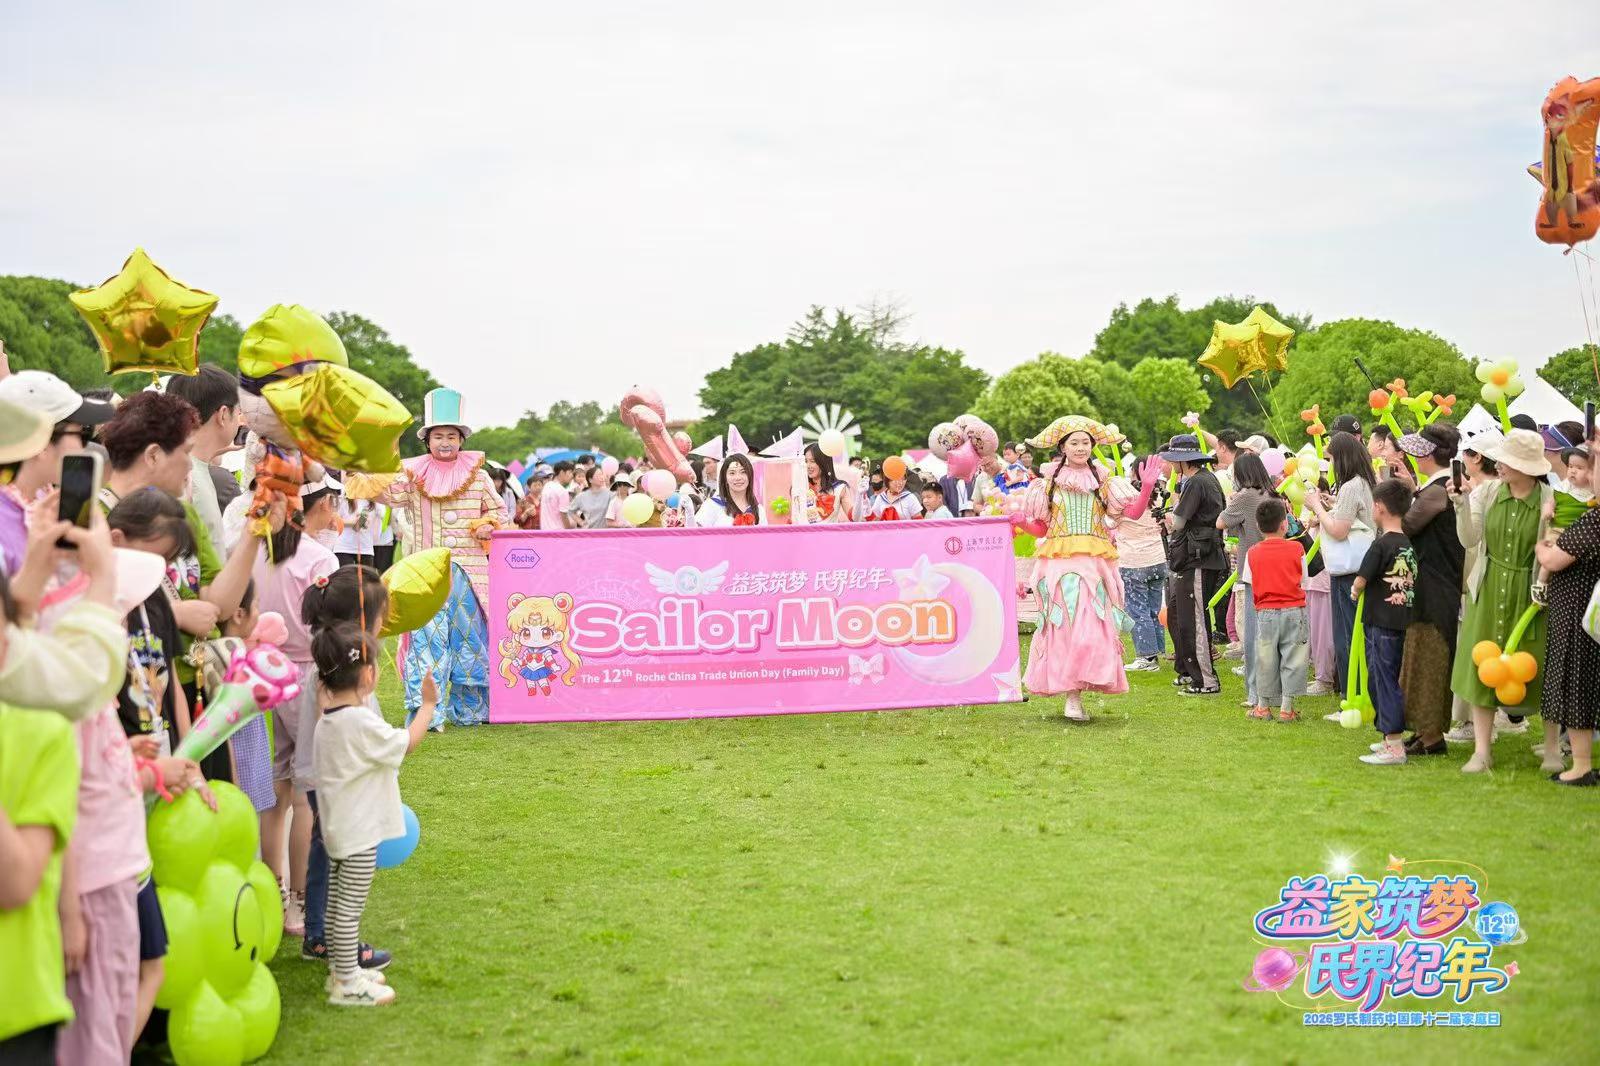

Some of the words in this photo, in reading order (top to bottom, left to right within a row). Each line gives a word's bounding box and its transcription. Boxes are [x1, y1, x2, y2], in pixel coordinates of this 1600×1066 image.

[511, 553, 535, 563] Roche
[722, 571, 809, 596] 益家筑梦
[814, 567, 893, 597] 氏界纪年
[569, 597, 771, 656] Sailor
[775, 597, 957, 650] Moon
[581, 674, 600, 683] The
[602, 668, 632, 684] 12th
[635, 673, 665, 682] Roche
[668, 671, 697, 681] China
[699, 671, 727, 680] Trade
[729, 669, 759, 679] Union
[761, 668, 780, 679] Day
[782, 666, 819, 678] (Family
[821, 665, 844, 676] Day)
